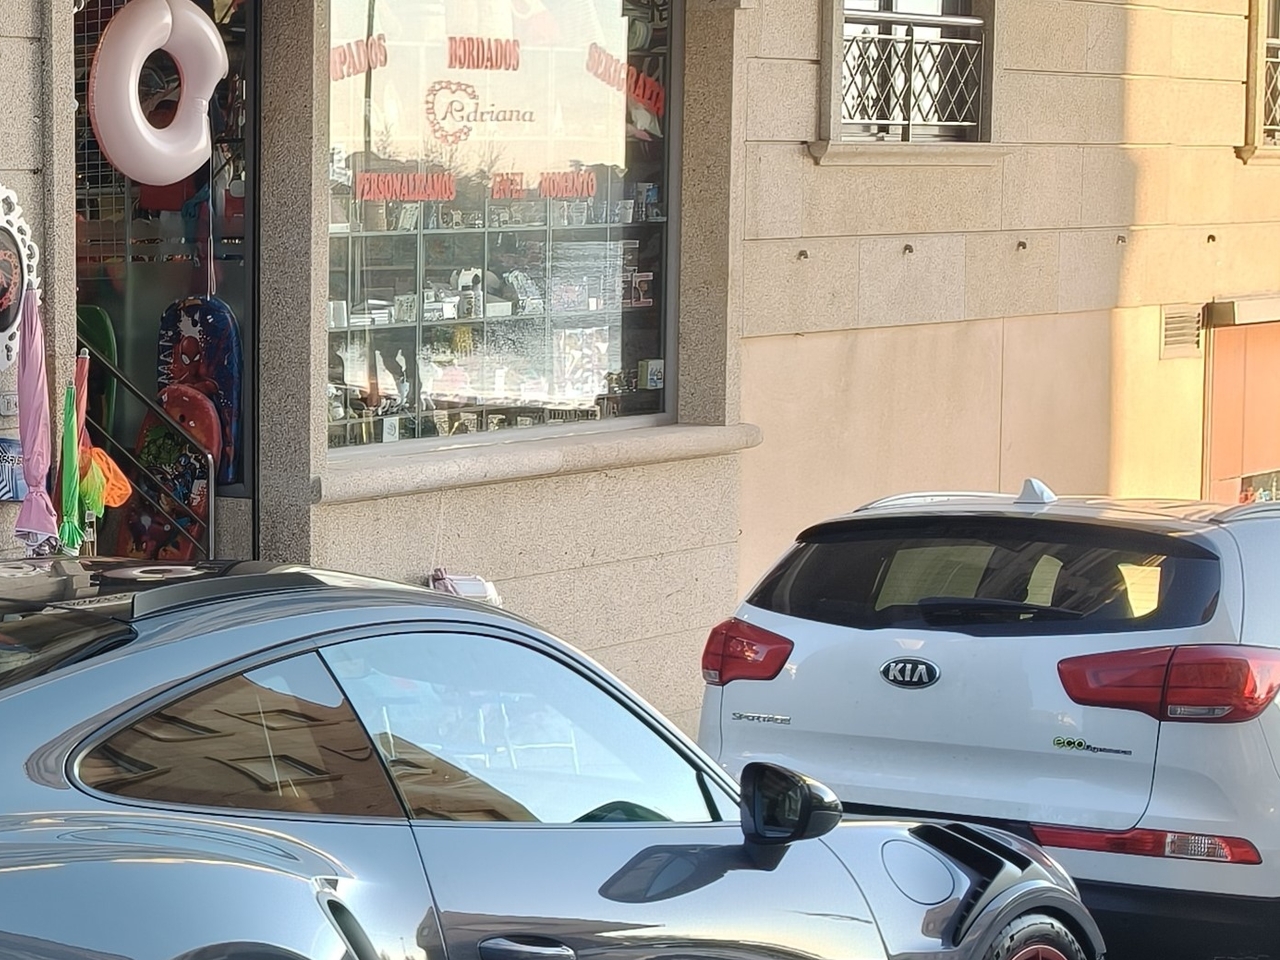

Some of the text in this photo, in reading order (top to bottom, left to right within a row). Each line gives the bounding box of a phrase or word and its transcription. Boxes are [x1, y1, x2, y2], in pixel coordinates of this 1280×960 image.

[447, 36, 520, 71] BORDADOS
[440, 99, 536, 122] Adriana
[356, 172, 456, 201] PERSONALIZAMOS
[540, 171, 596, 198] MOMENTO
[888, 662, 929, 682] KIA
